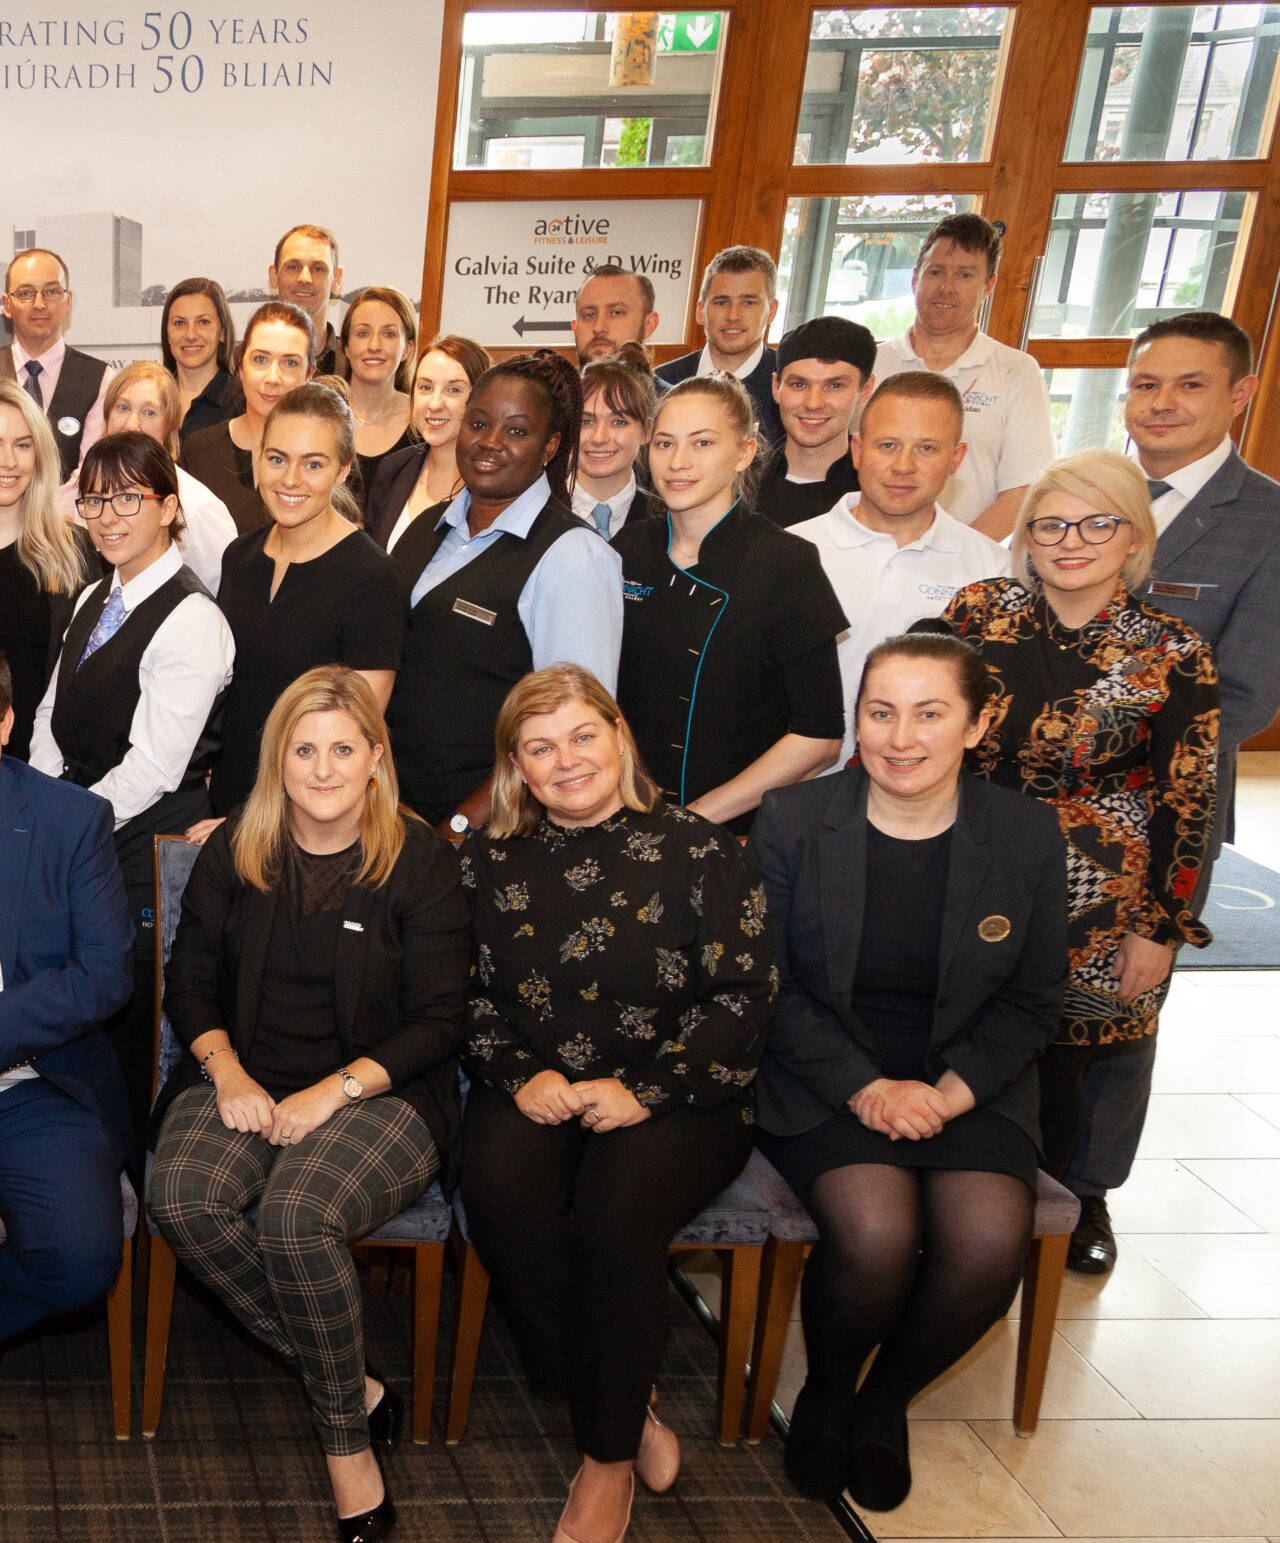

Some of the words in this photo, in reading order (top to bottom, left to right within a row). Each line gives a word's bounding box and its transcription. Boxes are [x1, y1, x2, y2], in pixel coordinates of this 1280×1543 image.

[141, 11, 192, 50] 50
[208, 18, 309, 45] YEARS
[153, 54, 204, 93] 50
[223, 61, 333, 87] BLIAIN
[534, 237, 566, 245] FITNESS
[575, 237, 608, 245] LEISURE
[455, 255, 519, 275] Galvia
[526, 254, 576, 275] Suite
[582, 255, 598, 274] &
[630, 253, 682, 280] Wing
[483, 285, 520, 304] The
